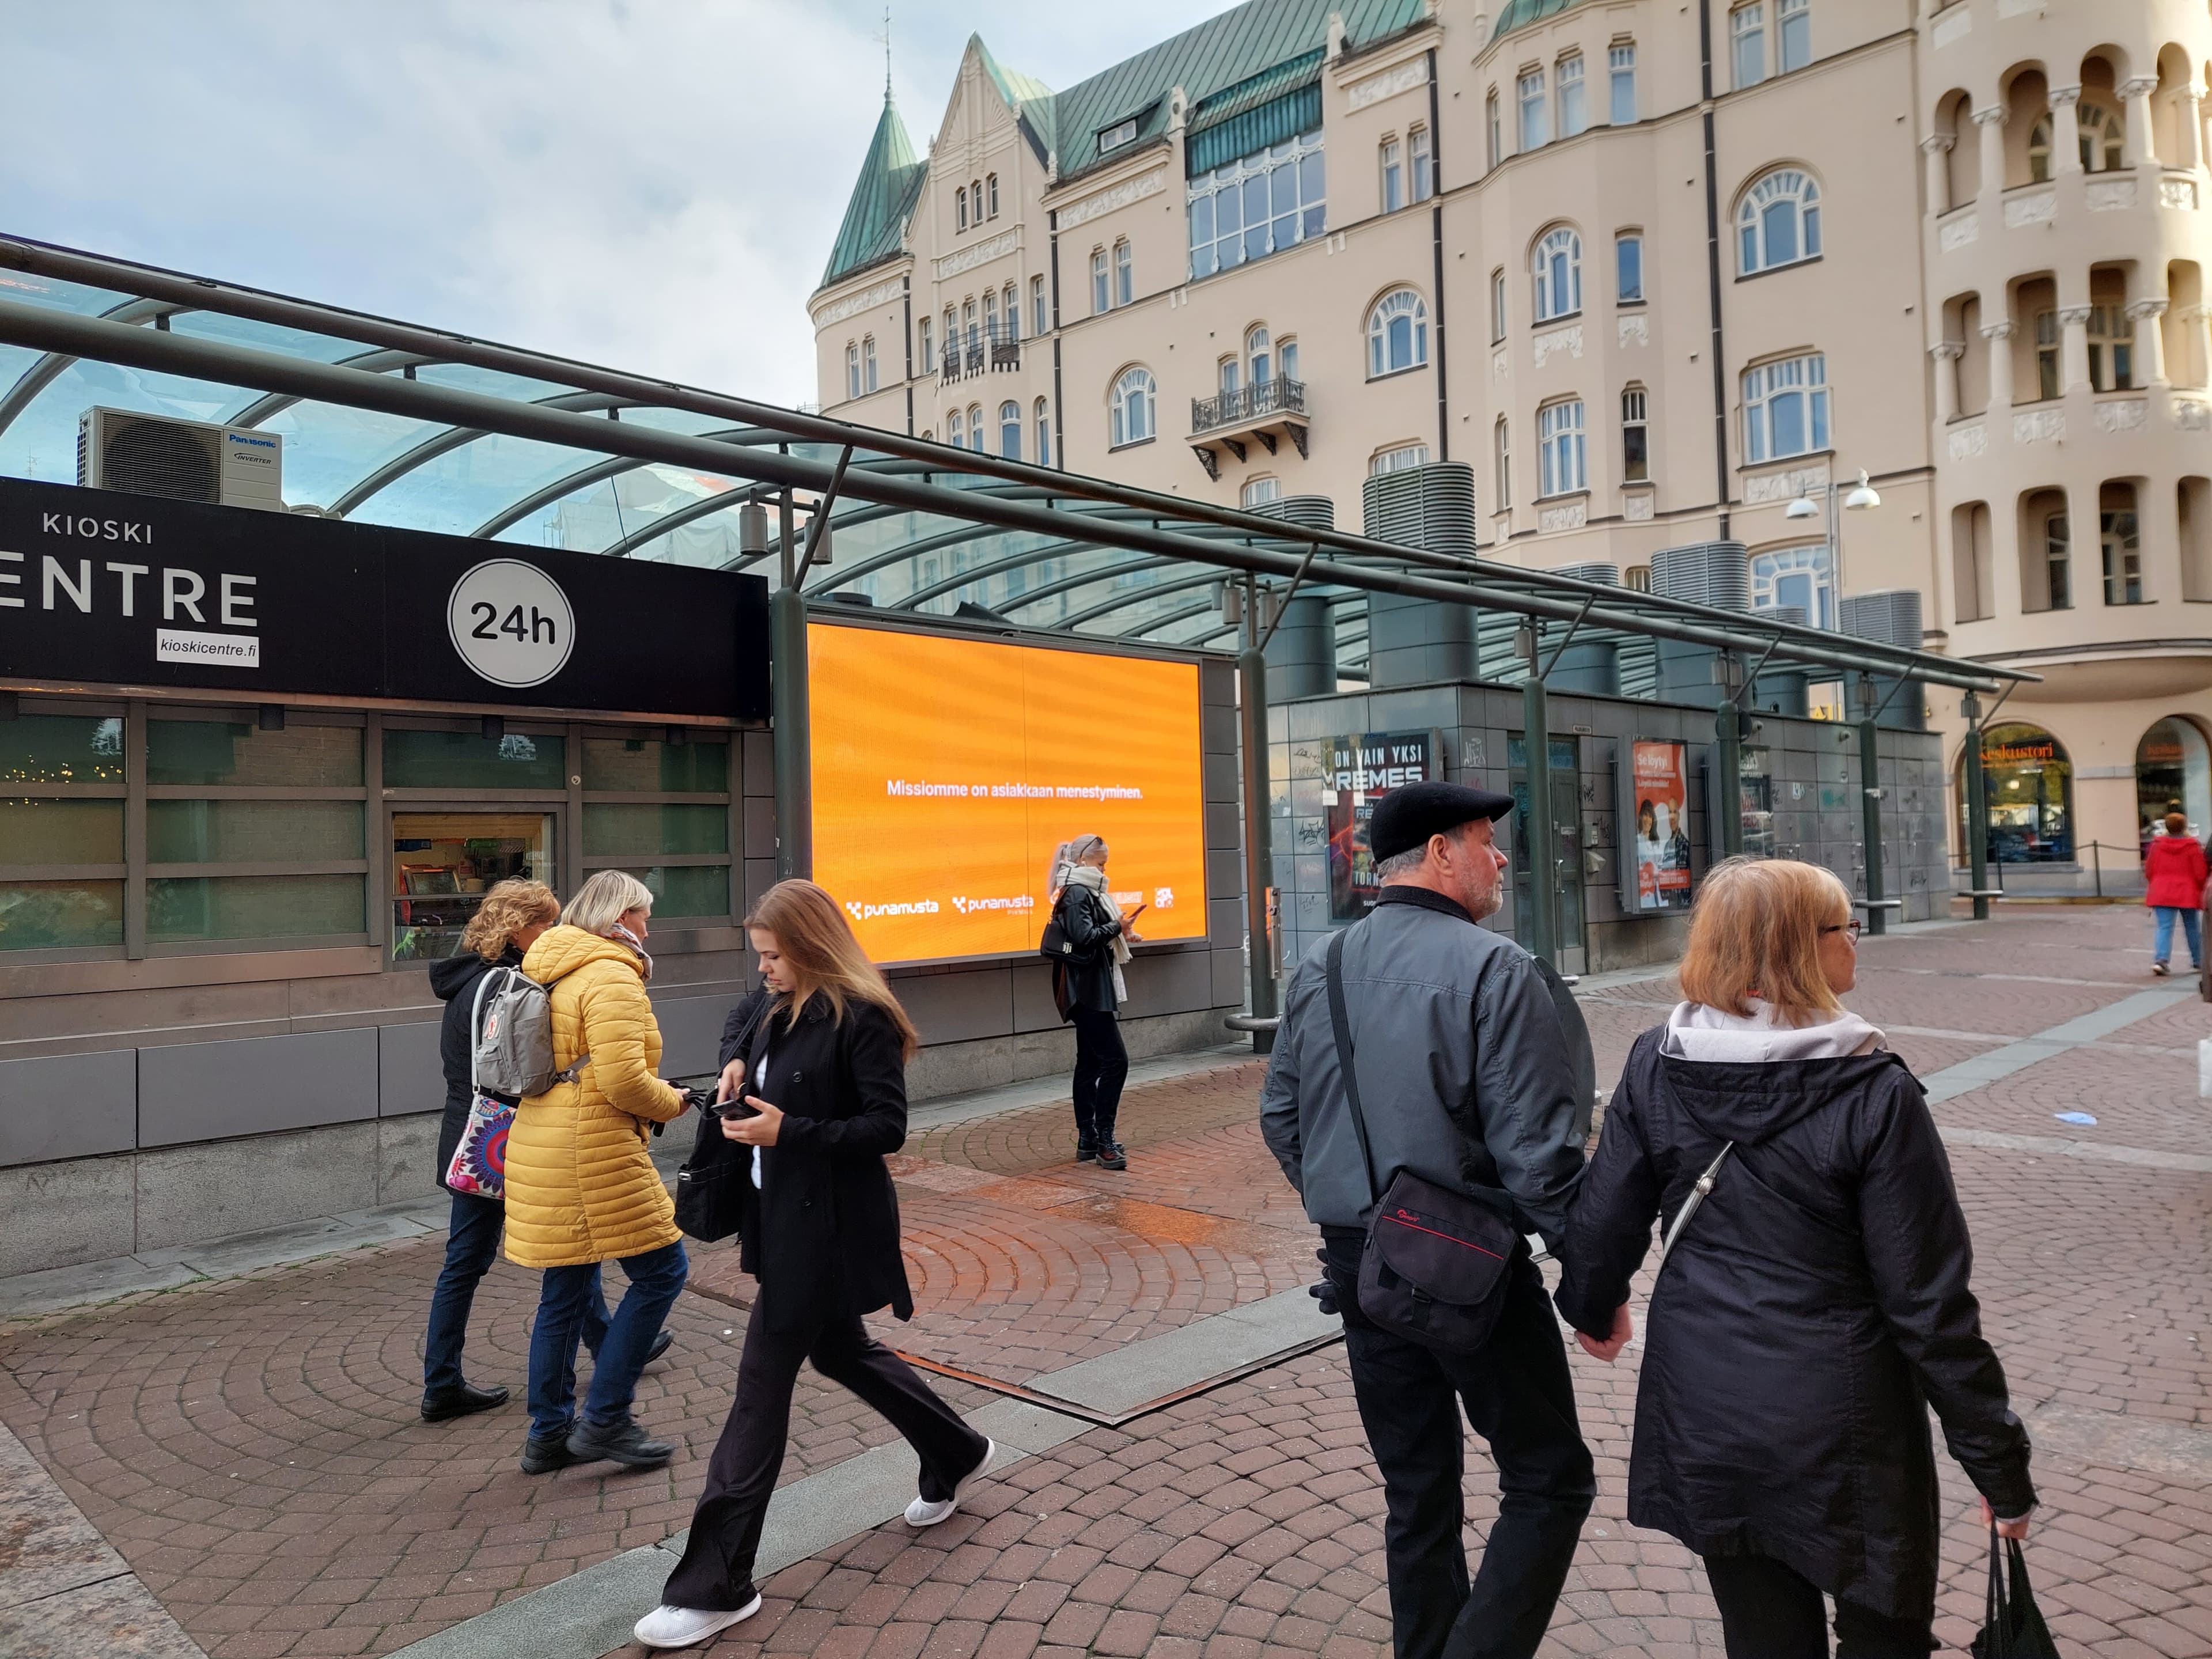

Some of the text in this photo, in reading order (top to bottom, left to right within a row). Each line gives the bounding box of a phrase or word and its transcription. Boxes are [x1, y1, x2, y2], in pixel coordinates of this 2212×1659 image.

[229, 434, 276, 448] Panasonic
[237, 454, 272, 464] INVERTER
[43, 512, 152, 544] KIOSKI
[471, 601, 555, 645] 24h
[161, 638, 256, 657] kioskicentre.fi
[1335, 750, 1350, 767] ON
[1357, 748, 1385, 766] VAIN
[1392, 744, 1422, 764] YKSI
[887, 779, 1143, 801] Missiomme on asiakkaan menestyminen.
[1355, 872, 1378, 887] TORN
[864, 899, 939, 919] punamusta
[968, 894, 1034, 912] punamusta
